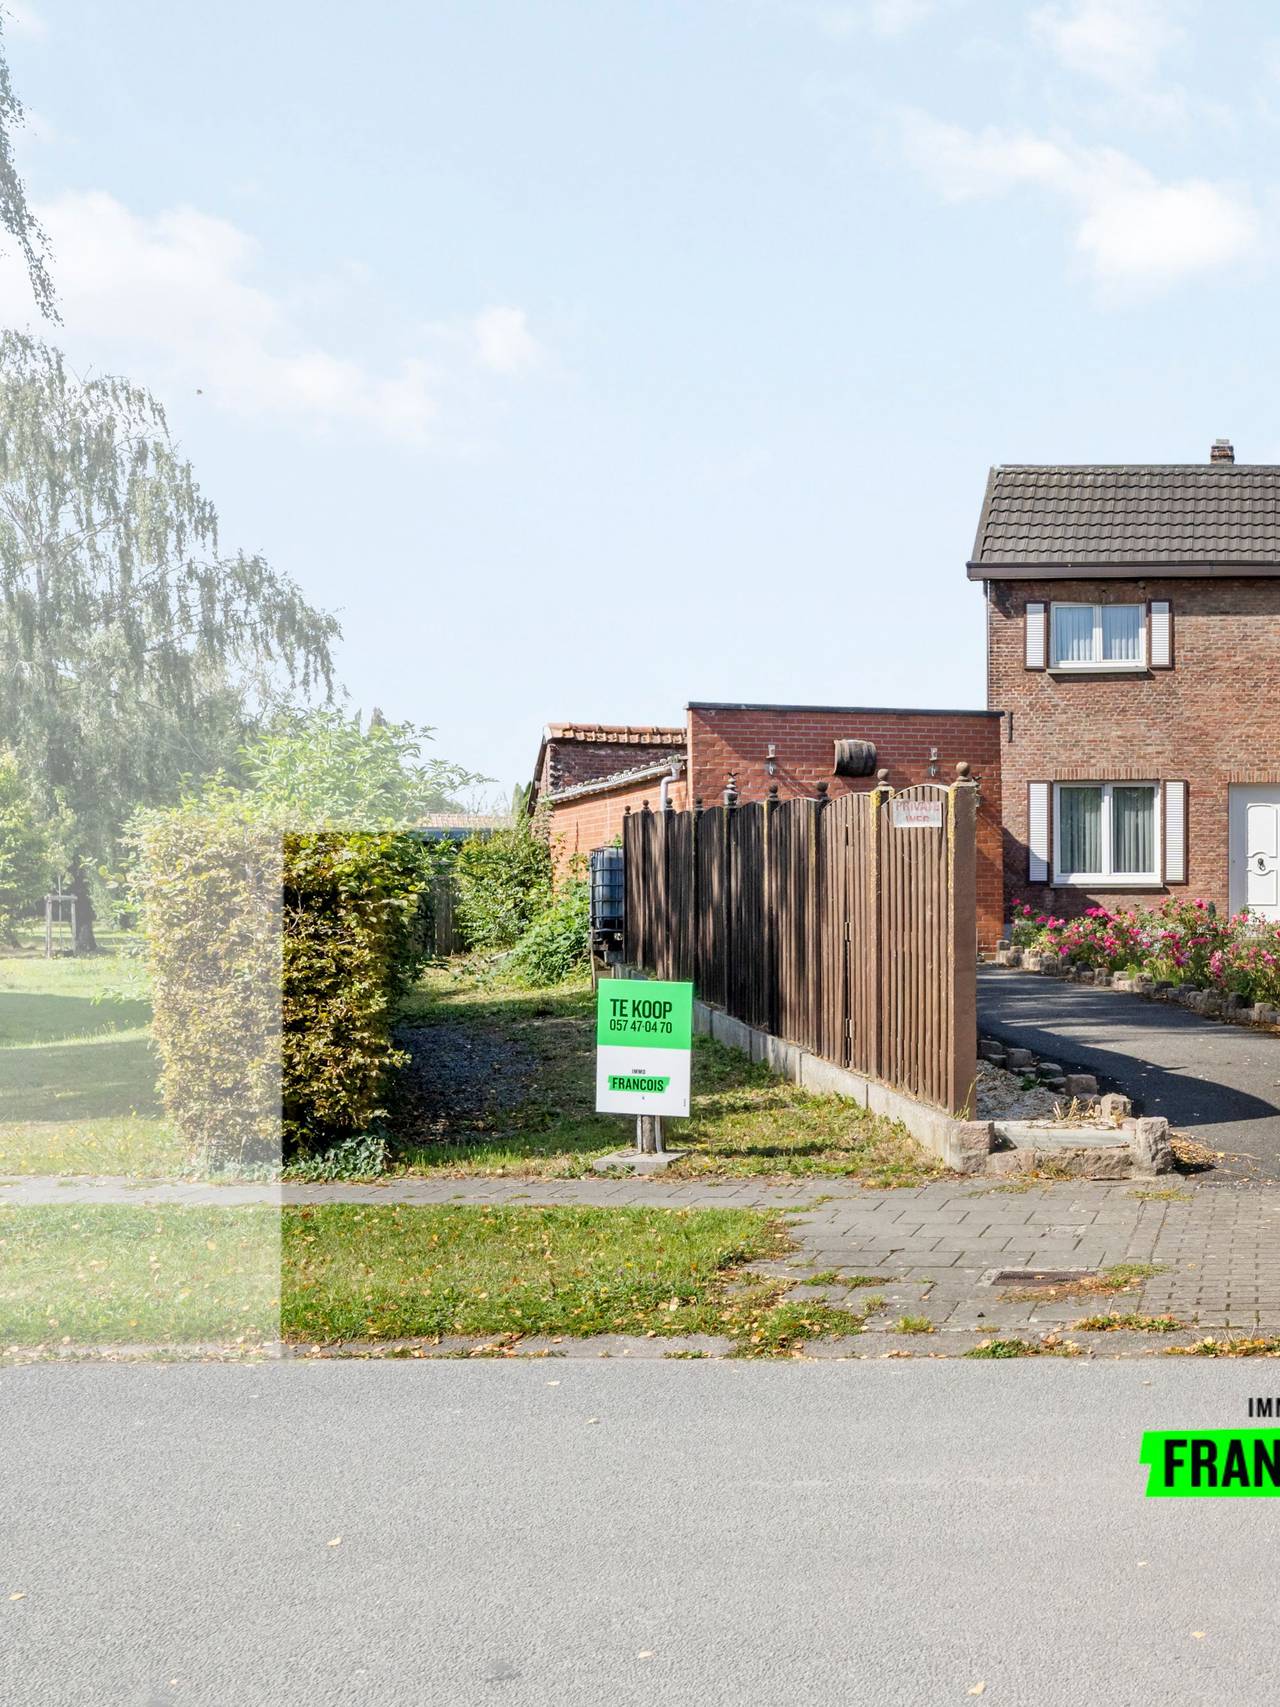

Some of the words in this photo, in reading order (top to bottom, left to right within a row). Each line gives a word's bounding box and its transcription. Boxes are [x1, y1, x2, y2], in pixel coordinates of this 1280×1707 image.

[610, 999, 628, 1017] TE
[632, 1000, 672, 1019] KOOP
[610, 1019, 628, 1031] 057
[631, 1020, 642, 1032] 47
[645, 1021, 657, 1033] 04
[660, 1022, 672, 1034] 70
[612, 1077, 664, 1092] FRANCOIS
